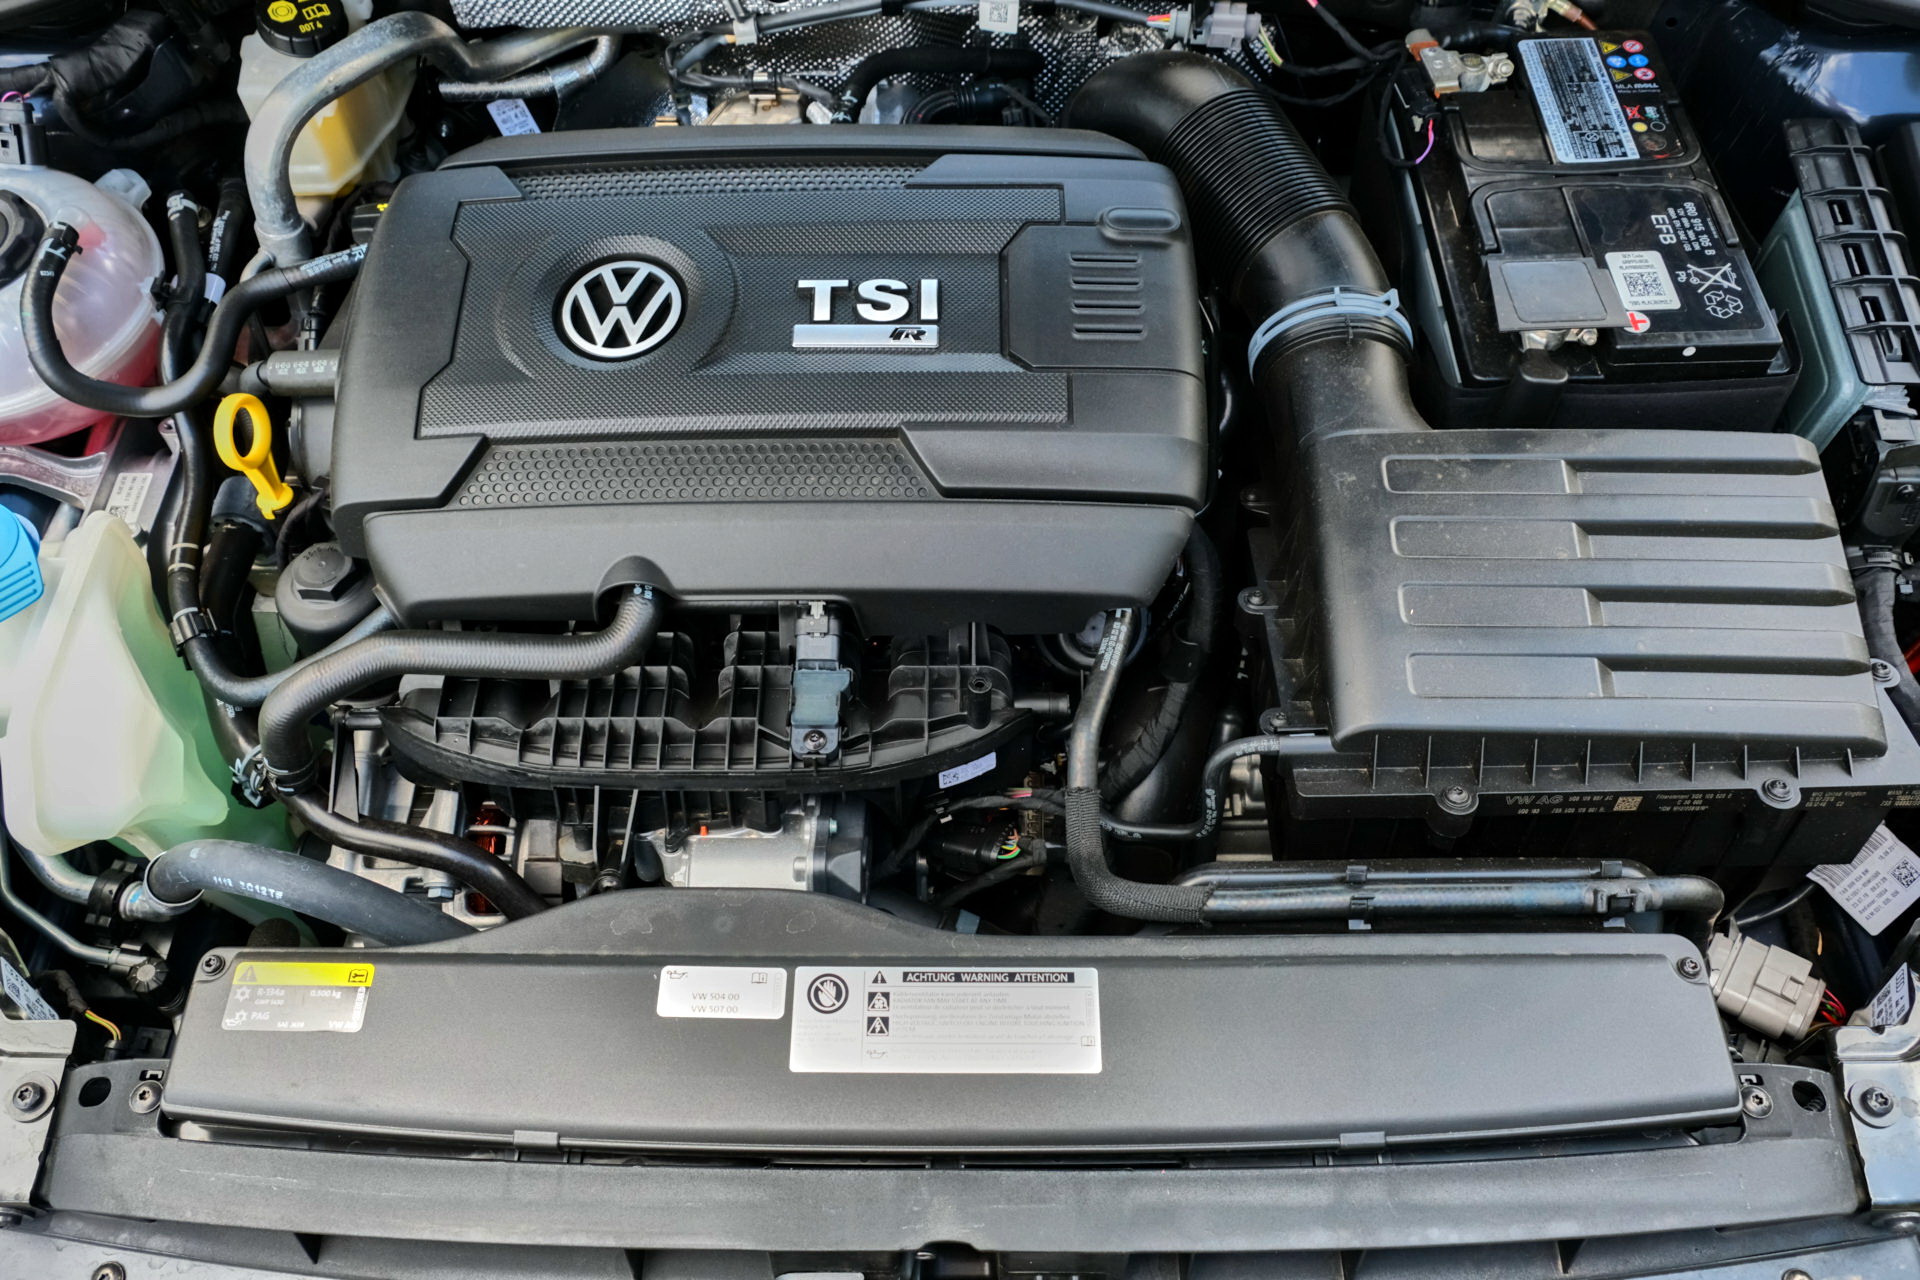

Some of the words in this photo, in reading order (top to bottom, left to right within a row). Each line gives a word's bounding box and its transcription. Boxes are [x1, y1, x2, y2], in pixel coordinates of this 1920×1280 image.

[299, 22, 314, 33] DOT
[316, 20, 323, 28] 4
[1682, 201, 1699, 216] 6R0
[1650, 214, 1678, 244] EFB
[1689, 218, 1706, 230] 915
[1696, 234, 1712, 246] 105
[1675, 270, 1687, 282] Pb
[798, 279, 938, 322] TSI
[1505, 795, 1535, 805] VW
[1536, 794, 1563, 804] AG
[906, 973, 955, 982] ACHTUNG
[961, 973, 1009, 982] WARNING
[1014, 973, 1068, 982] ATTENTION
[251, 1012, 270, 1020] PAG
